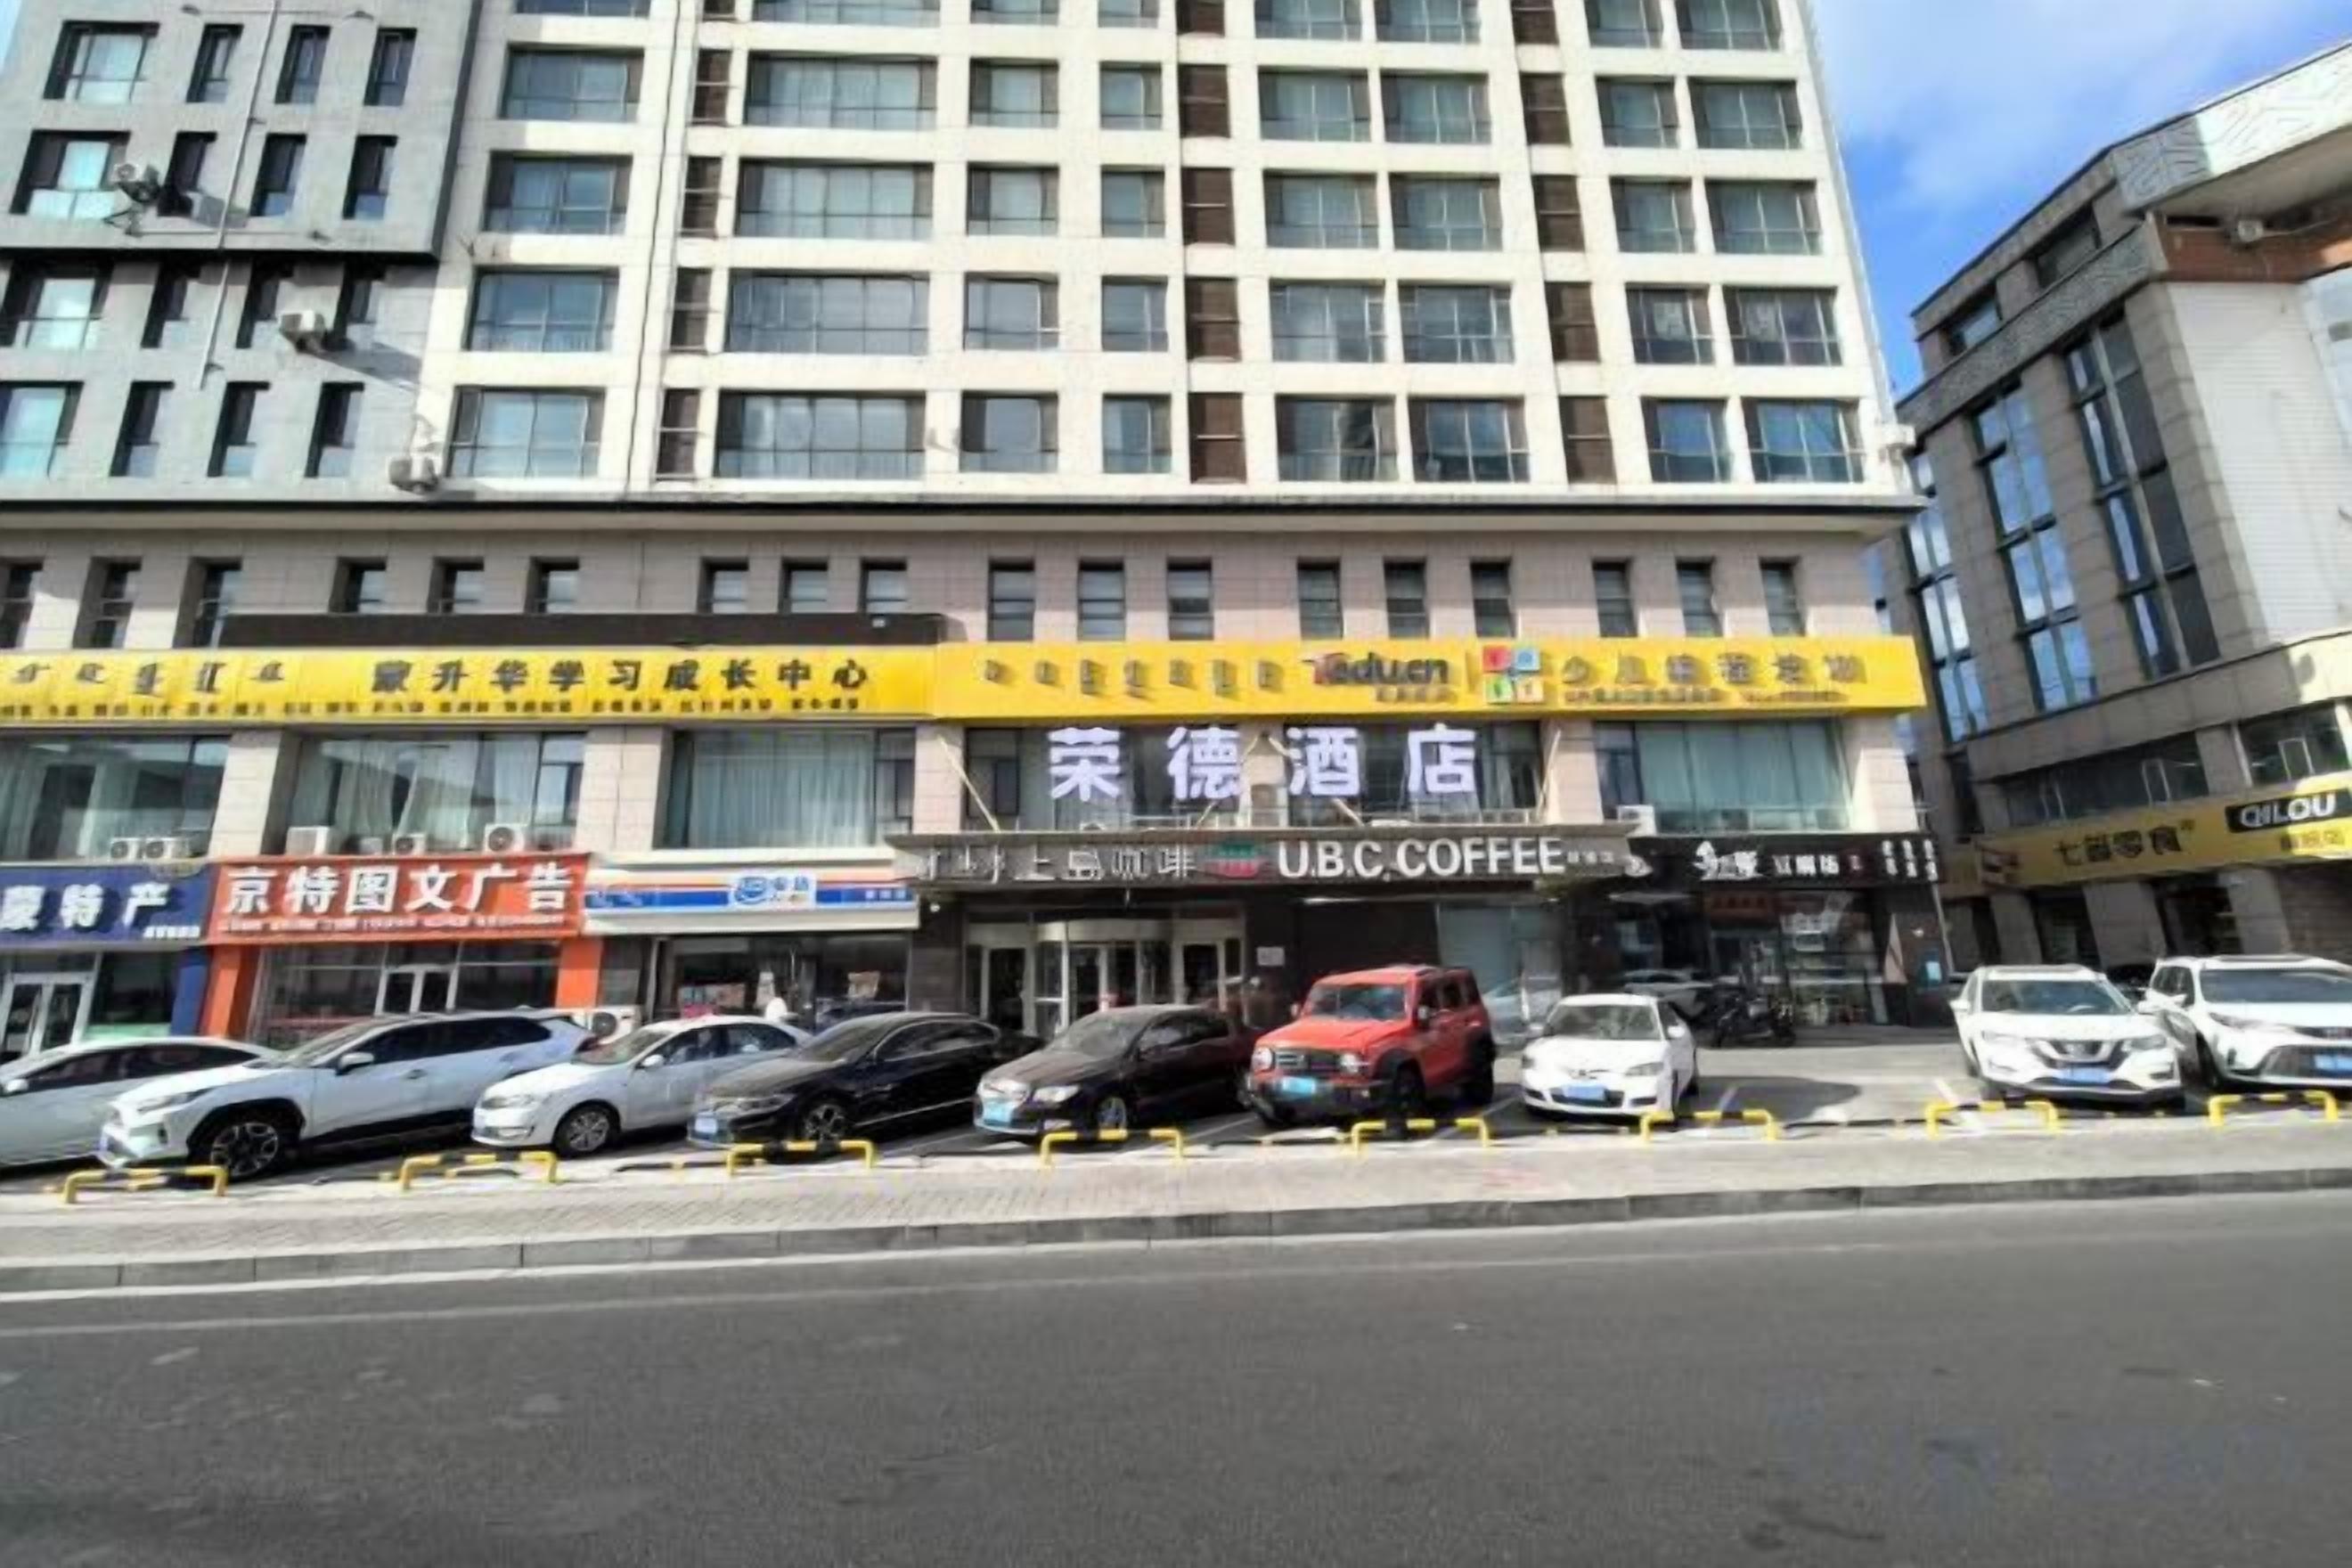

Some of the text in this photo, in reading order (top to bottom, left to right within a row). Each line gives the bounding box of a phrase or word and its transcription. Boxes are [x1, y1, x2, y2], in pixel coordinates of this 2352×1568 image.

[1048, 723, 1476, 801] 荣德酒店
[2240, 790, 2337, 828] QILOU
[227, 862, 571, 913] 京特图文广告
